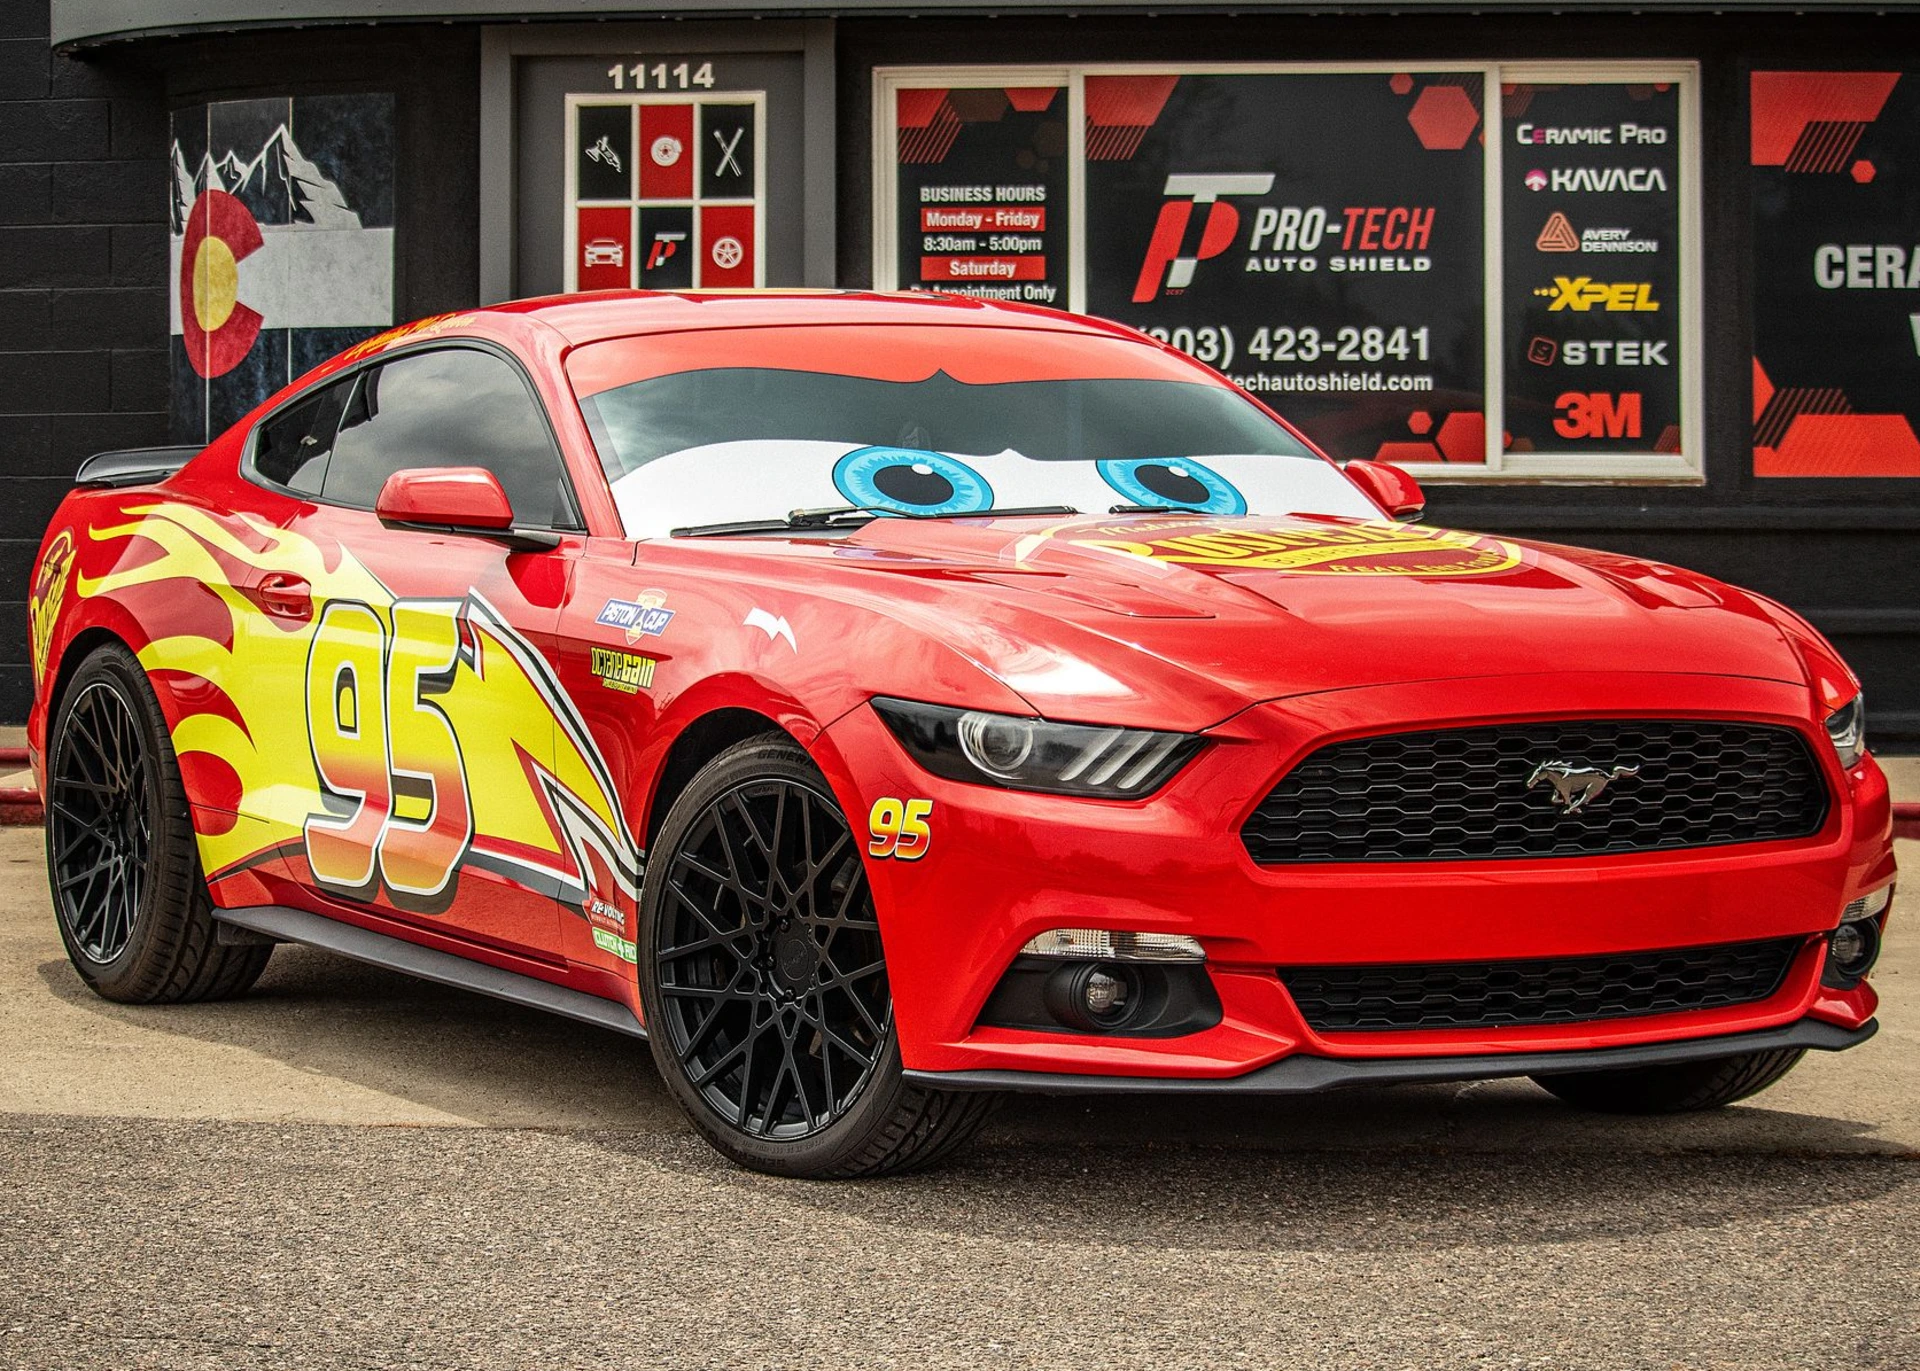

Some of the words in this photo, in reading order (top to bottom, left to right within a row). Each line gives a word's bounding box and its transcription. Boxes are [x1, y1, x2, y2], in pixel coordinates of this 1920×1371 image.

[607, 62, 715, 89] 11114
[1551, 168, 1667, 193] KAVACA
[920, 186, 992, 203] BUSINESS
[995, 186, 1046, 202] HOURS
[926, 211, 981, 230] Monday
[995, 211, 1040, 230] Friday
[1249, 205, 1436, 252] PRO-TECH
[923, 237, 976, 253] 8:30am
[989, 237, 1042, 256] 5:00pm
[1581, 228, 1630, 241] AVERY
[1581, 240, 1658, 253] DENNISON
[949, 260, 1016, 279] Saturday
[1245, 256, 1318, 272] AUTO
[1329, 256, 1432, 272] SHIELD
[1023, 284, 1056, 304] Only
[1548, 275, 1660, 312] XPEL
[1247, 326, 1430, 362] 423-2841
[1562, 340, 1669, 366] STEK
[1552, 391, 1643, 439] 3M
[600, 601, 640, 627] PISTON
[643, 610, 670, 631] CUP
[302, 598, 477, 905] 95
[757, 748, 820, 770] GENERA
[868, 796, 933, 862] 95
